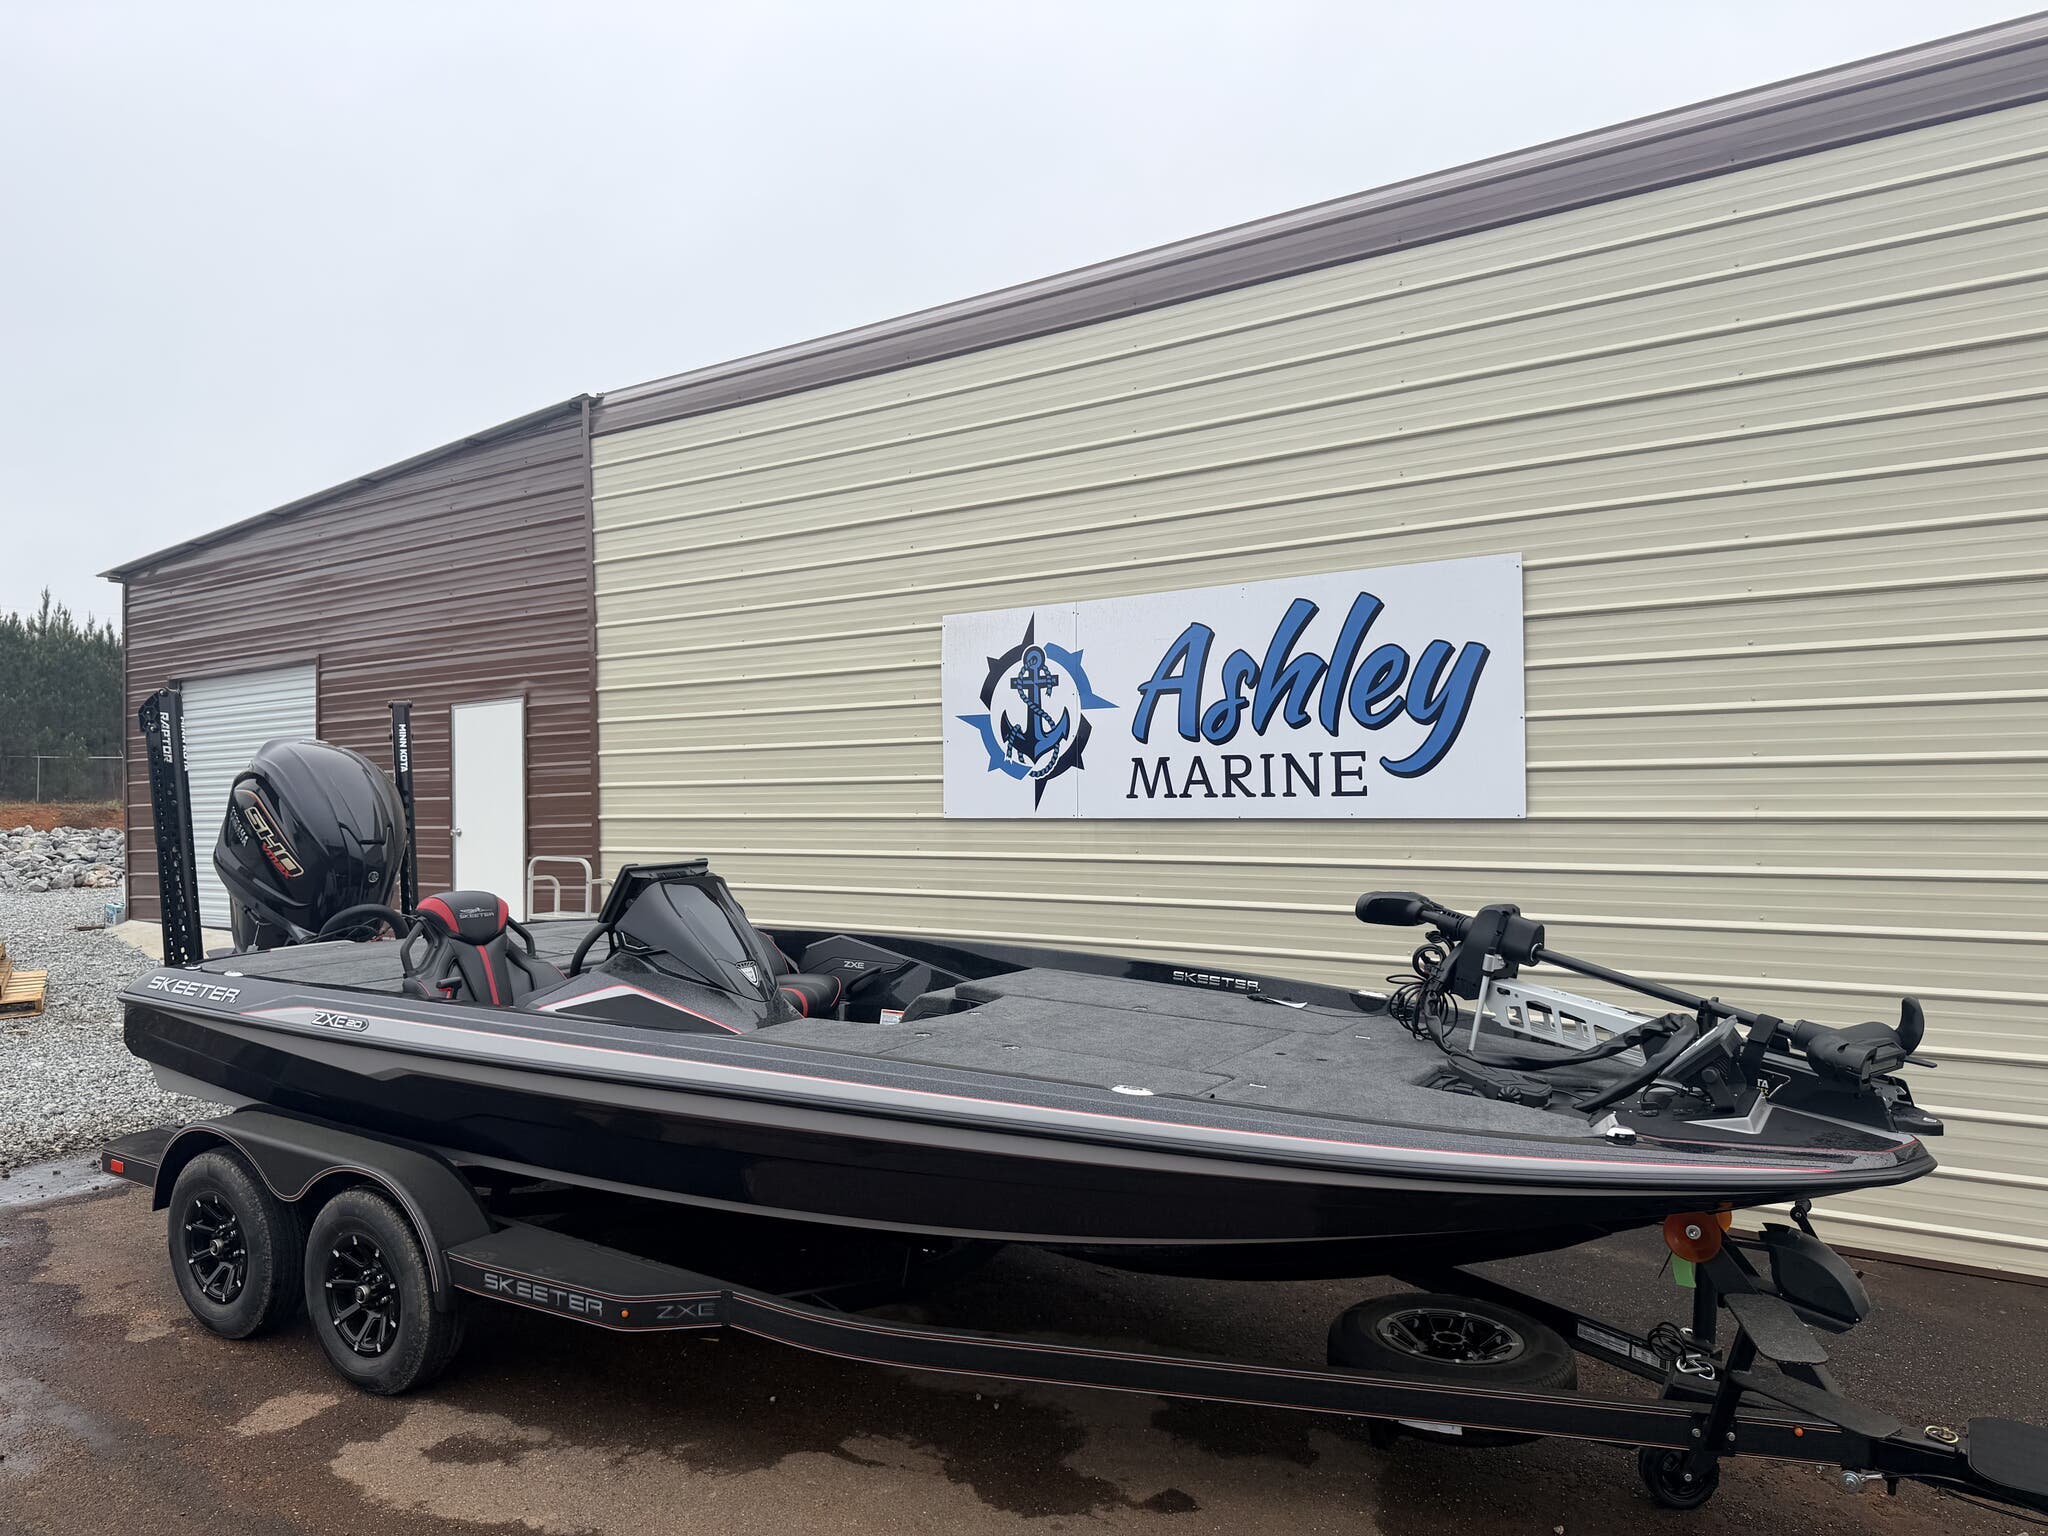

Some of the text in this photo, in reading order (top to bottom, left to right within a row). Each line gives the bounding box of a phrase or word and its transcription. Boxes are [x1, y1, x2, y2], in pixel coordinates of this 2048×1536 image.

[1132, 591, 1490, 778] Ashley
[160, 711, 173, 763] RAPTOR
[398, 723, 409, 773] MINN KOTA
[1126, 750, 1368, 799] MARINE
[244, 806, 304, 877] SHO
[843, 960, 865, 969] ZXE
[1172, 970, 1260, 992] SKEETER
[147, 975, 241, 1004] SKEETER
[484, 1272, 603, 1317] SKEETER
[656, 1302, 716, 1320] ZXE
